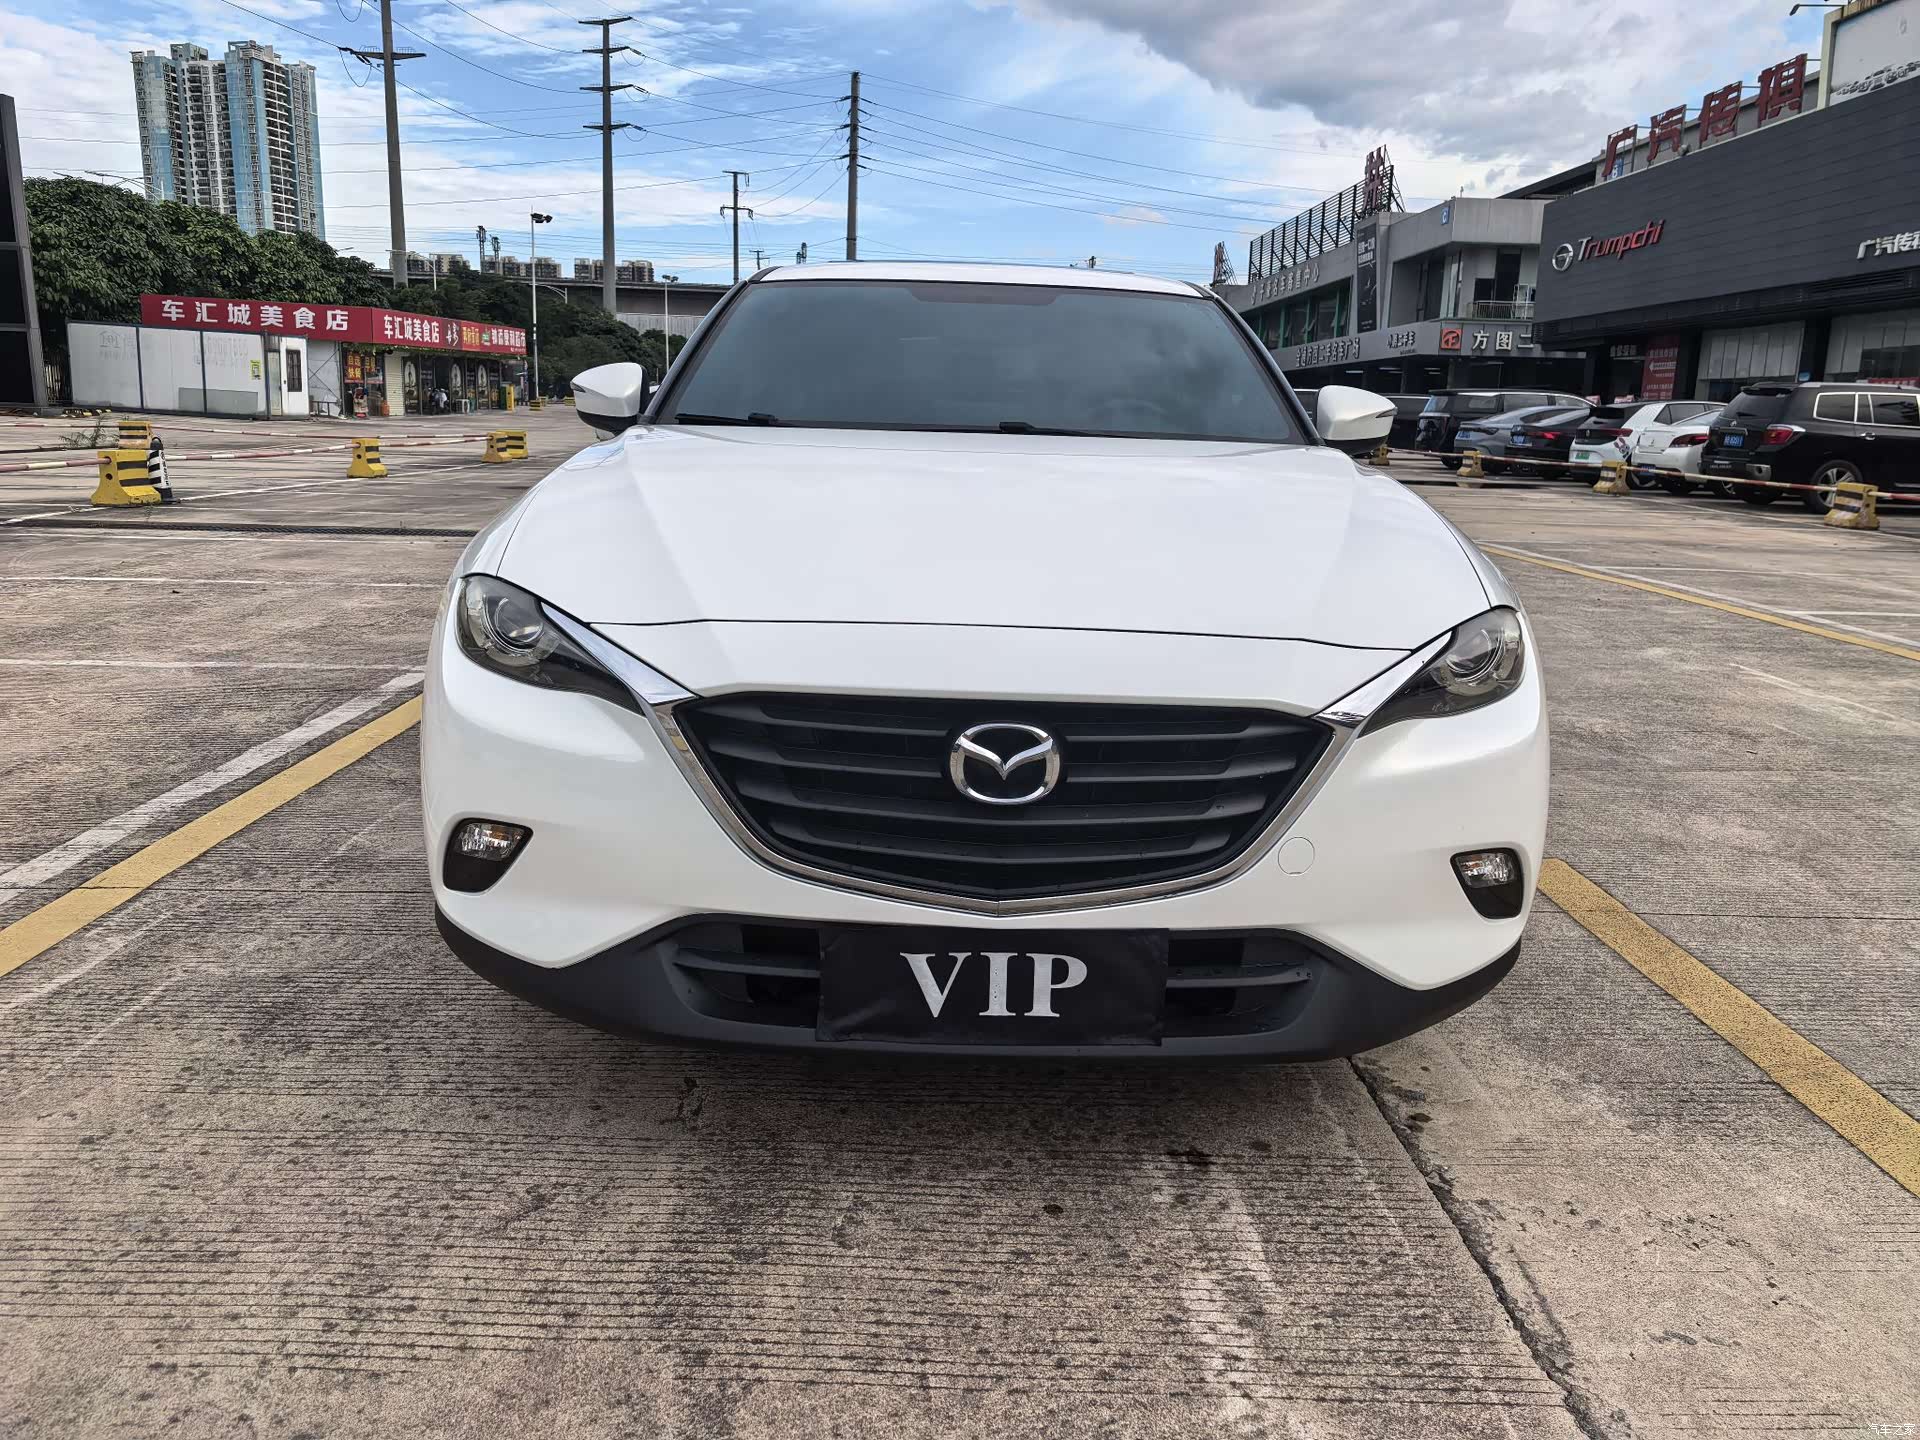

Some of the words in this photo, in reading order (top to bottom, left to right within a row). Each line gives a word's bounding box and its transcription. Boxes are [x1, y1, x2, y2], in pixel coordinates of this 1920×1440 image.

[1578, 219, 1665, 261] Trumpchi
[162, 299, 349, 331] 车汇城美食店
[384, 314, 440, 343] 车汇城美食店
[900, 951, 1088, 1018] VIP
